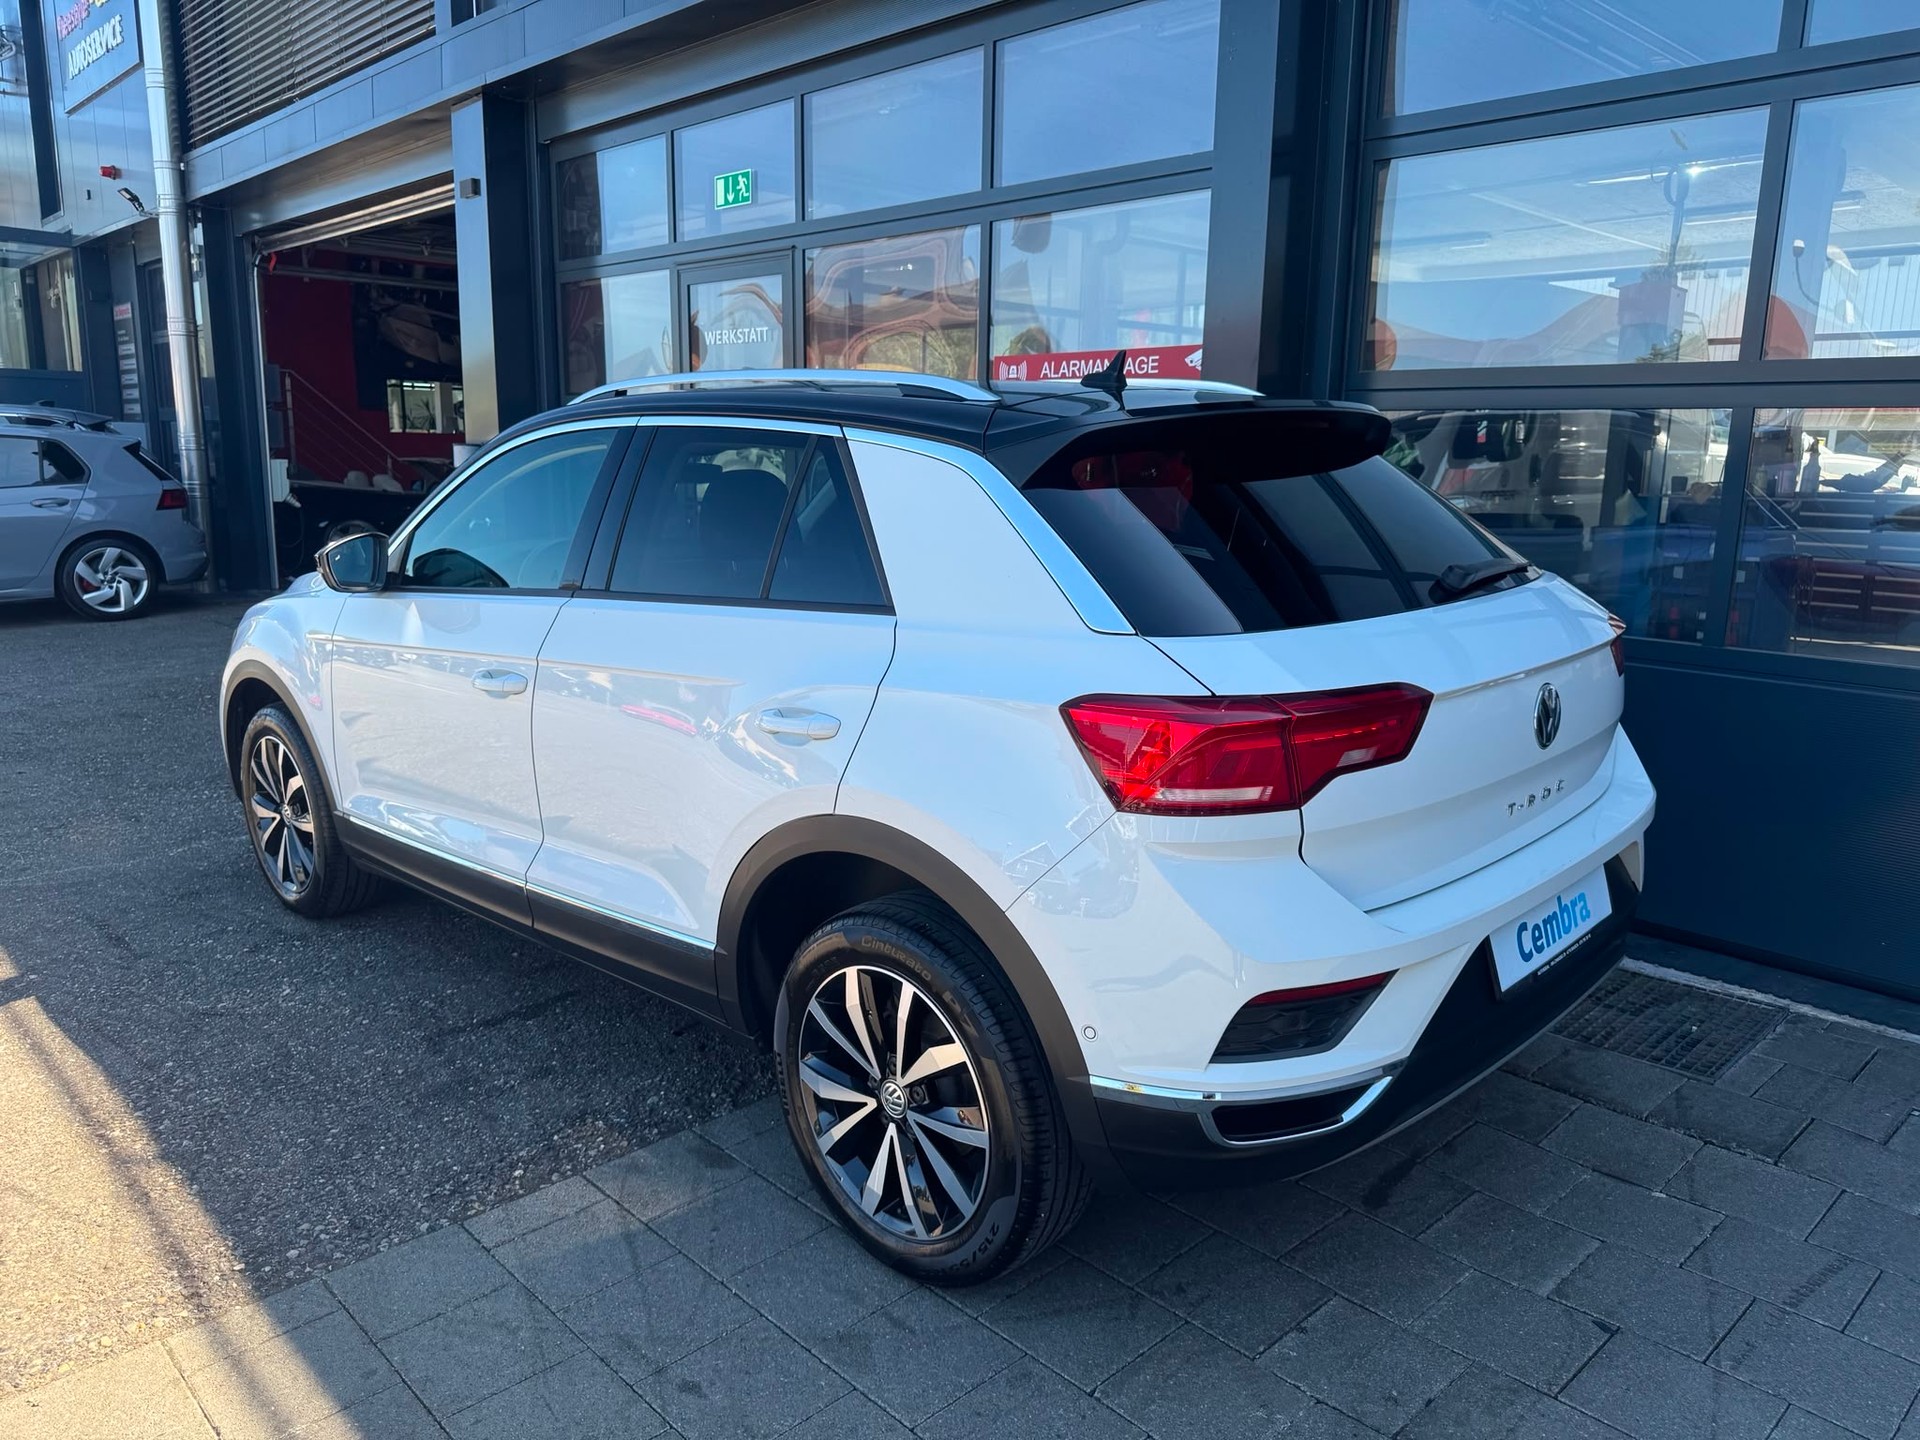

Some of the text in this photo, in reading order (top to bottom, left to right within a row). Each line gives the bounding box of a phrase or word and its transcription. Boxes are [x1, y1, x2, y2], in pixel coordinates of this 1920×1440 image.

[68, 14, 123, 80] AUTOSERVICE
[704, 327, 769, 345] WERKSTATT
[1040, 355, 1160, 378] ALARMAAGE
[1516, 892, 1591, 963] Cembra
[861, 935, 933, 981] Cinturato
